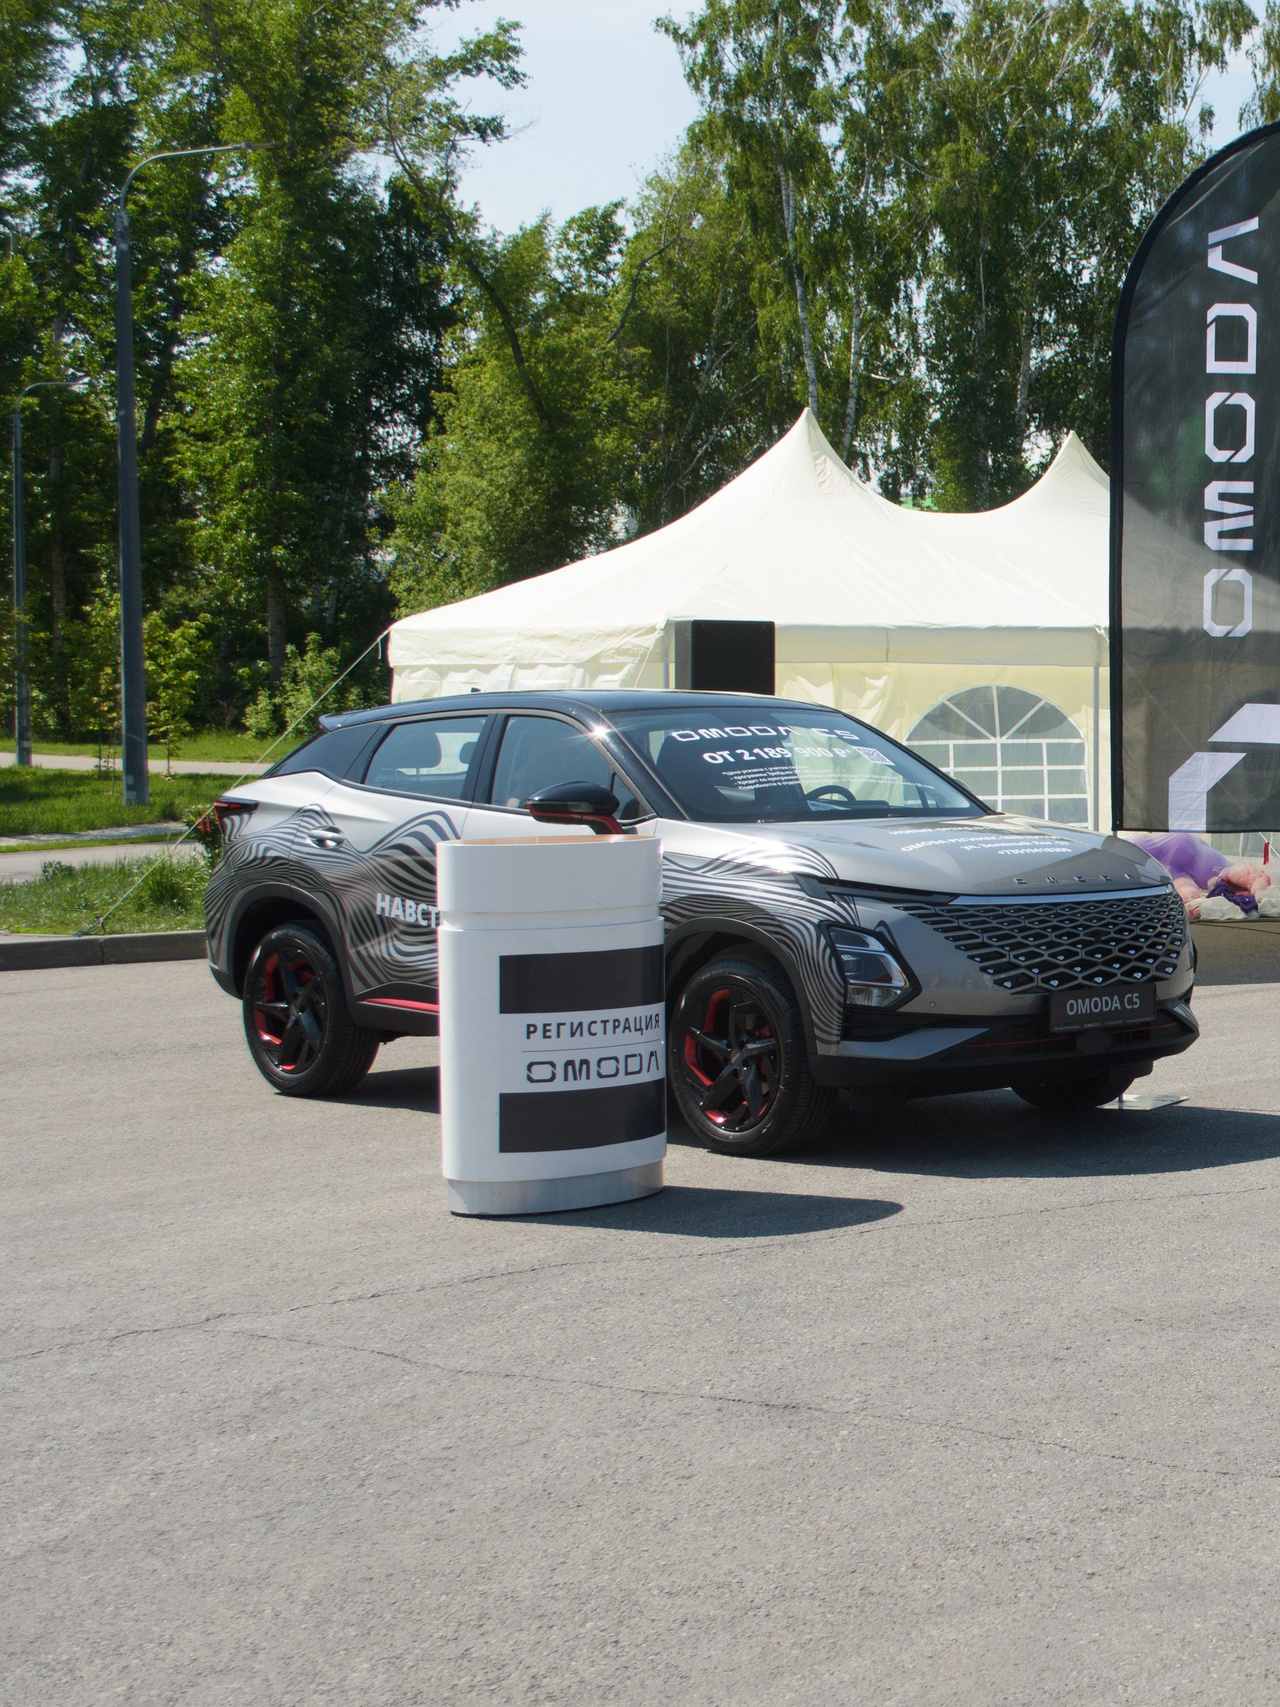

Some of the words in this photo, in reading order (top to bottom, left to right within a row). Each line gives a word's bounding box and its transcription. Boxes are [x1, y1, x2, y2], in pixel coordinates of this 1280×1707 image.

[1203, 216, 1259, 638] OMODA
[671, 725, 802, 742] OMODA
[702, 750, 735, 764] ОТ
[1066, 995, 1121, 1015] OMODA
[1124, 993, 1140, 1009] C5
[526, 1013, 660, 1040] РЕГИСТРАЦИЯ
[526, 1050, 660, 1084] OMODA
